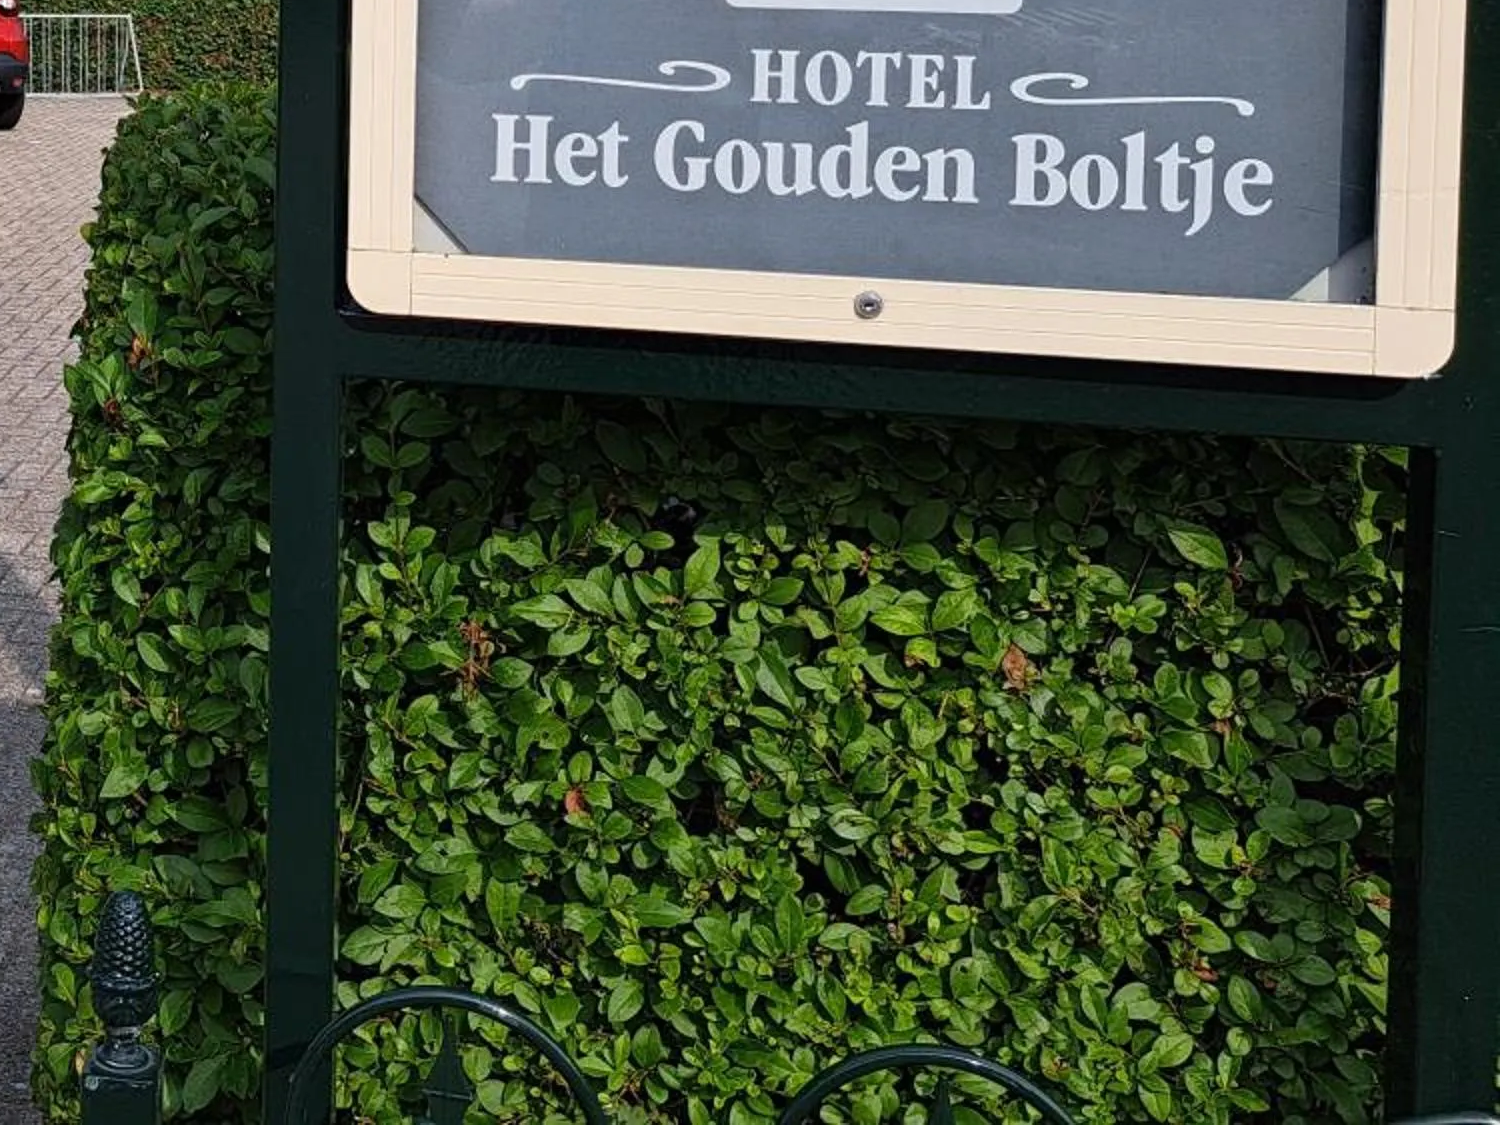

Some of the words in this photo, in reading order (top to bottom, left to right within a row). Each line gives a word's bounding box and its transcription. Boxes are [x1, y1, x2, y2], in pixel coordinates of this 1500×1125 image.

[750, 48, 992, 111] HOTEL
[490, 112, 629, 189] Het
[653, 120, 980, 206] Gouden
[1009, 133, 1275, 237] Boltje
